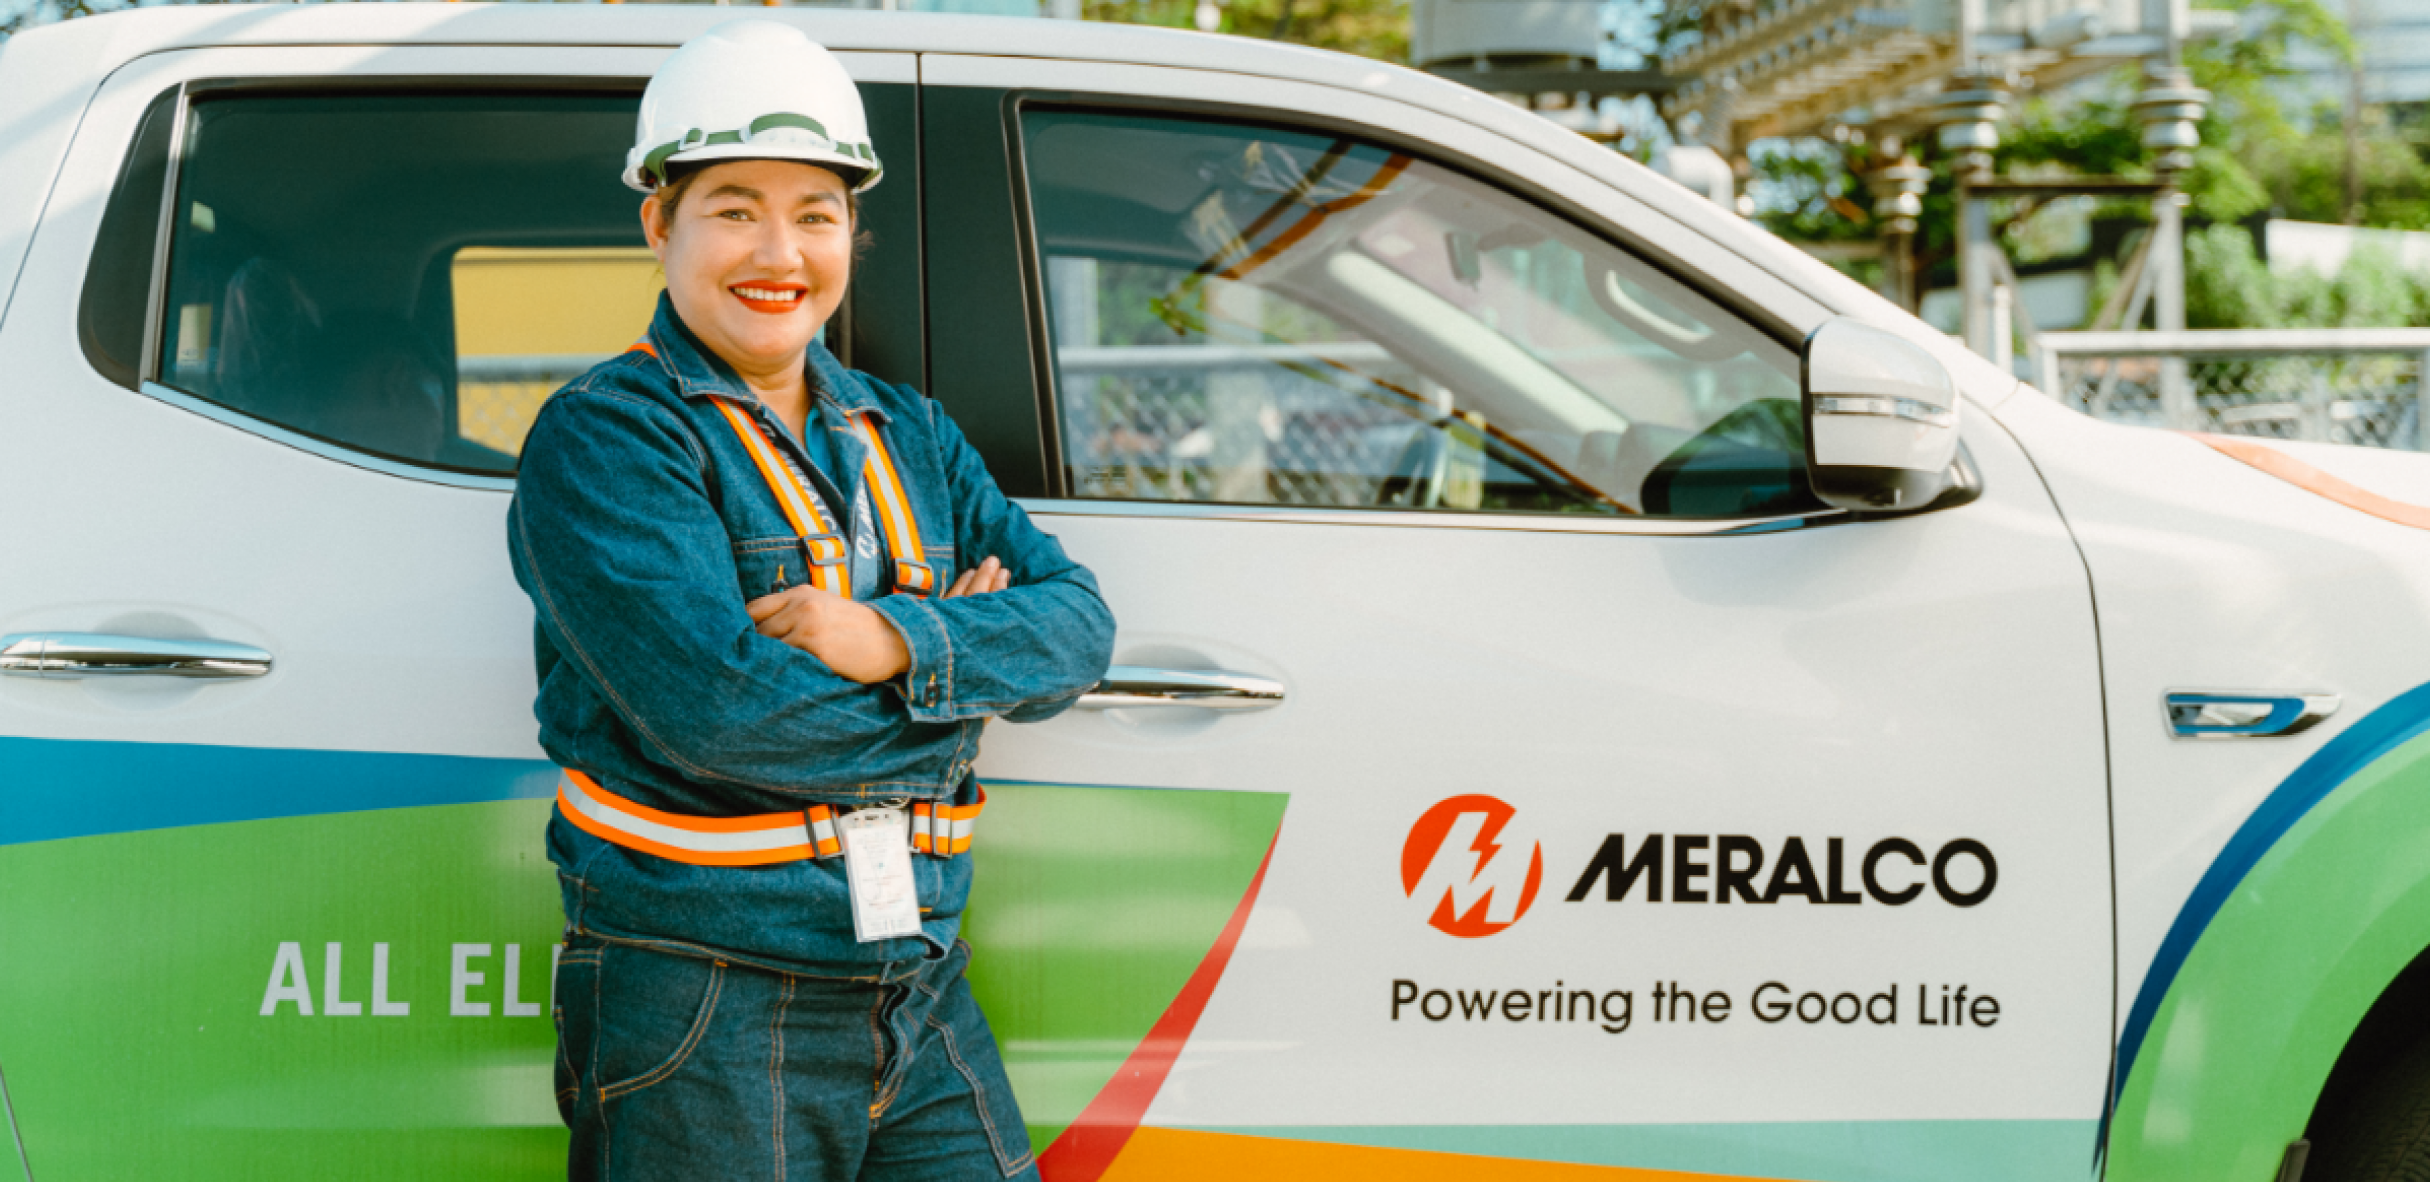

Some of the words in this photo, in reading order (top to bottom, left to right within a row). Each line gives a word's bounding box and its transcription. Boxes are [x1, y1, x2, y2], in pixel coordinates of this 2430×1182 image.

[1565, 834, 1998, 907] MERALCO
[259, 941, 411, 1016] ALL
[1391, 979, 1633, 1034] Powering
[1652, 981, 1731, 1023] the
[1751, 982, 1897, 1024] Good
[1918, 984, 2000, 1027] Life
